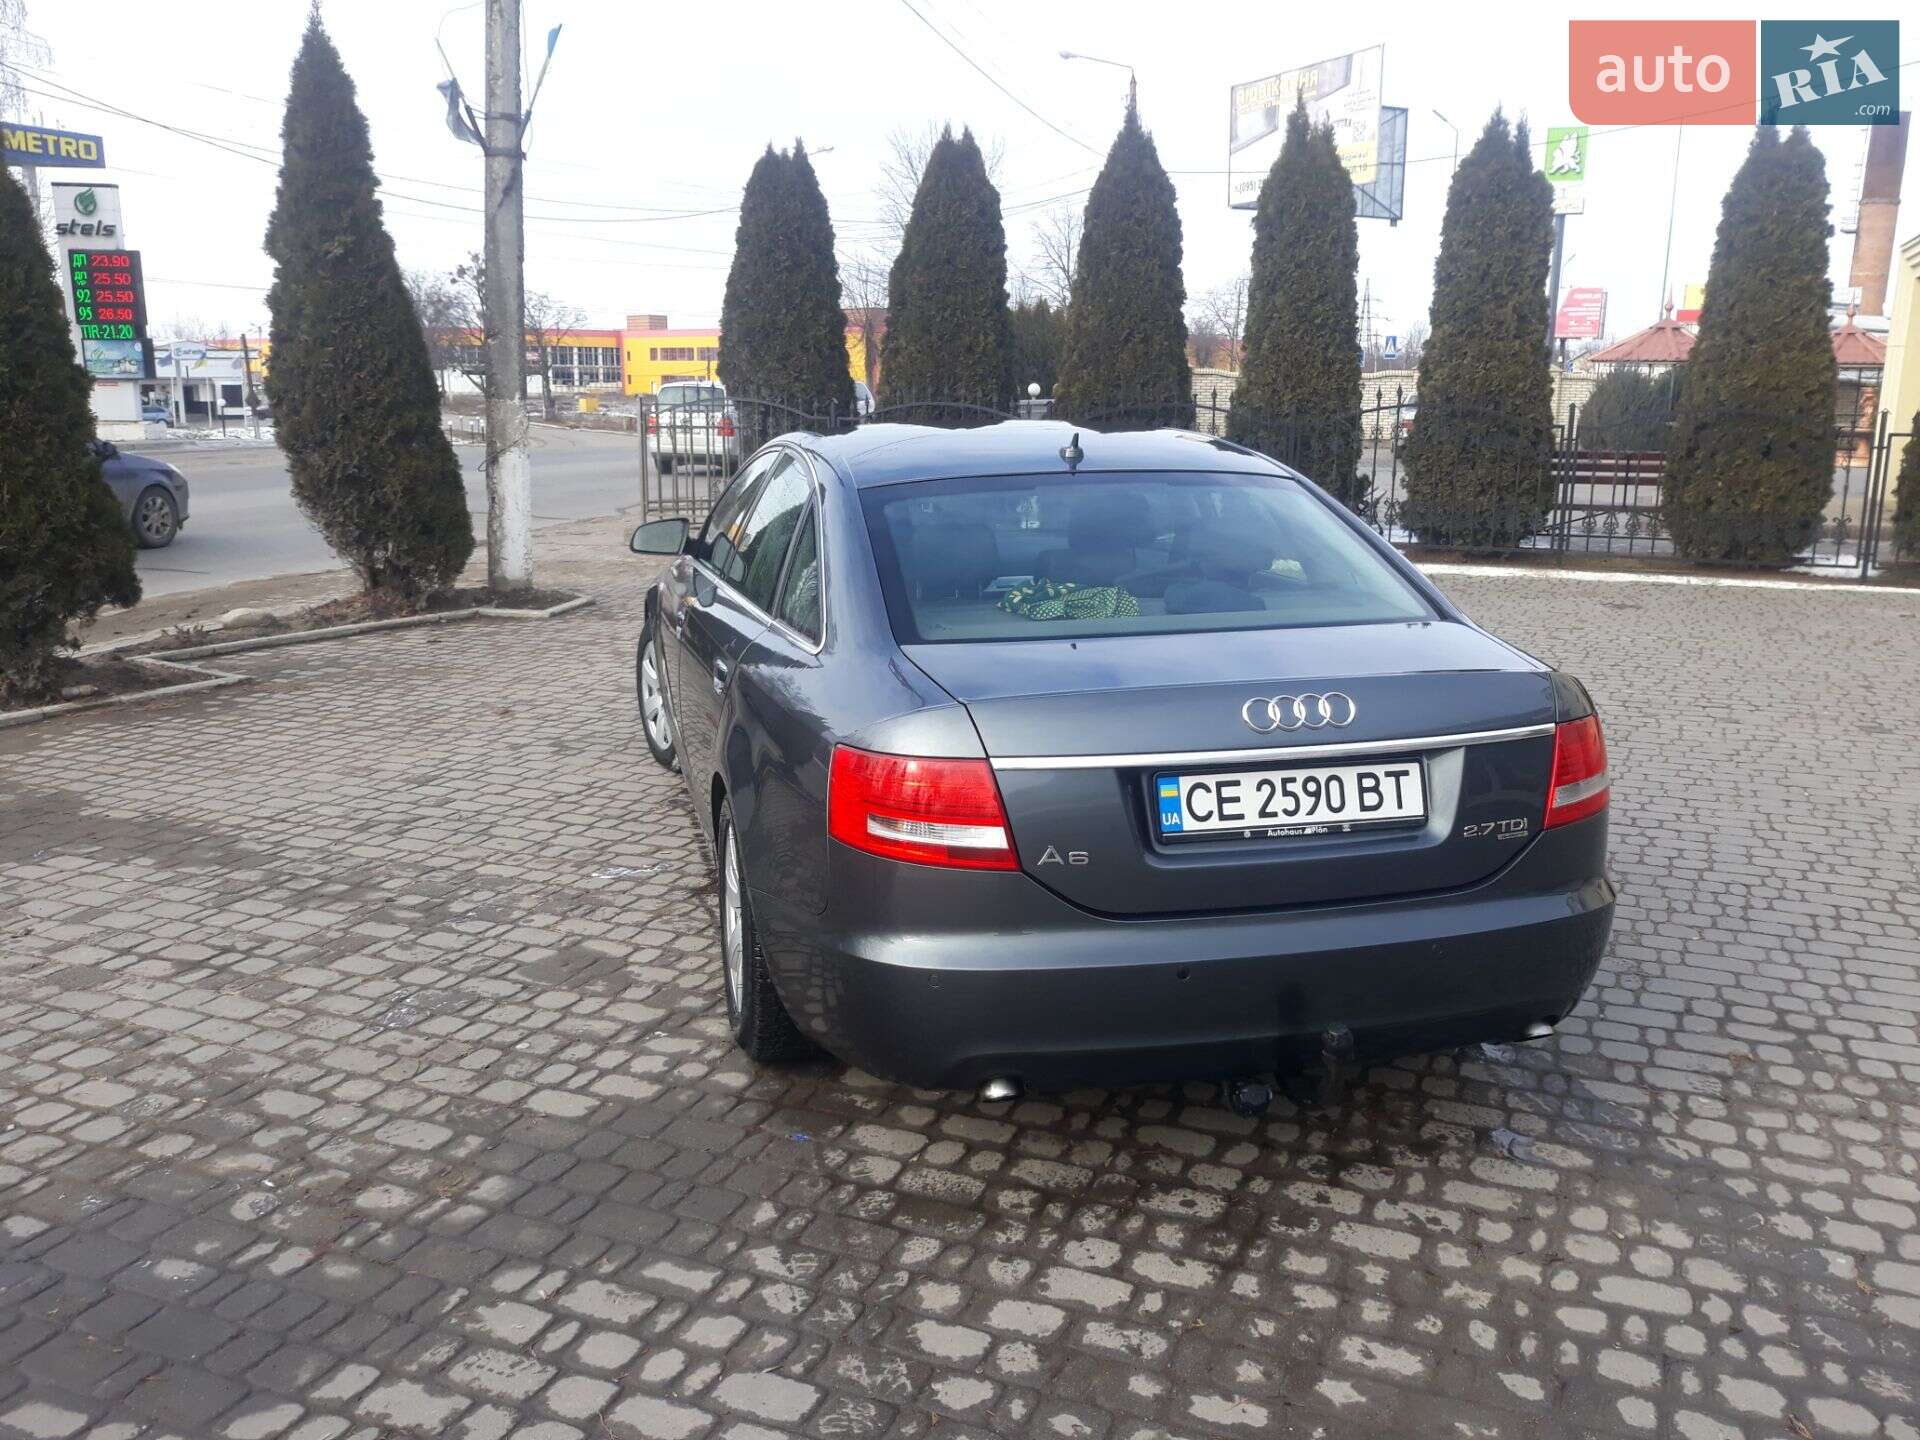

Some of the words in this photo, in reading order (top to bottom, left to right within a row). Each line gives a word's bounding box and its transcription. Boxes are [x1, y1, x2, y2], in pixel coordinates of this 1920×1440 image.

[3, 128, 98, 161] METRO
[55, 218, 116, 237] stels
[76, 288, 91, 303] 92
[78, 306, 93, 321] 95
[1186, 779, 1245, 823] CE
[1256, 774, 1346, 819] 2590
[1356, 769, 1410, 813] BT
[1162, 812, 1181, 826] UA
[1267, 829, 1302, 837] Autohaus
